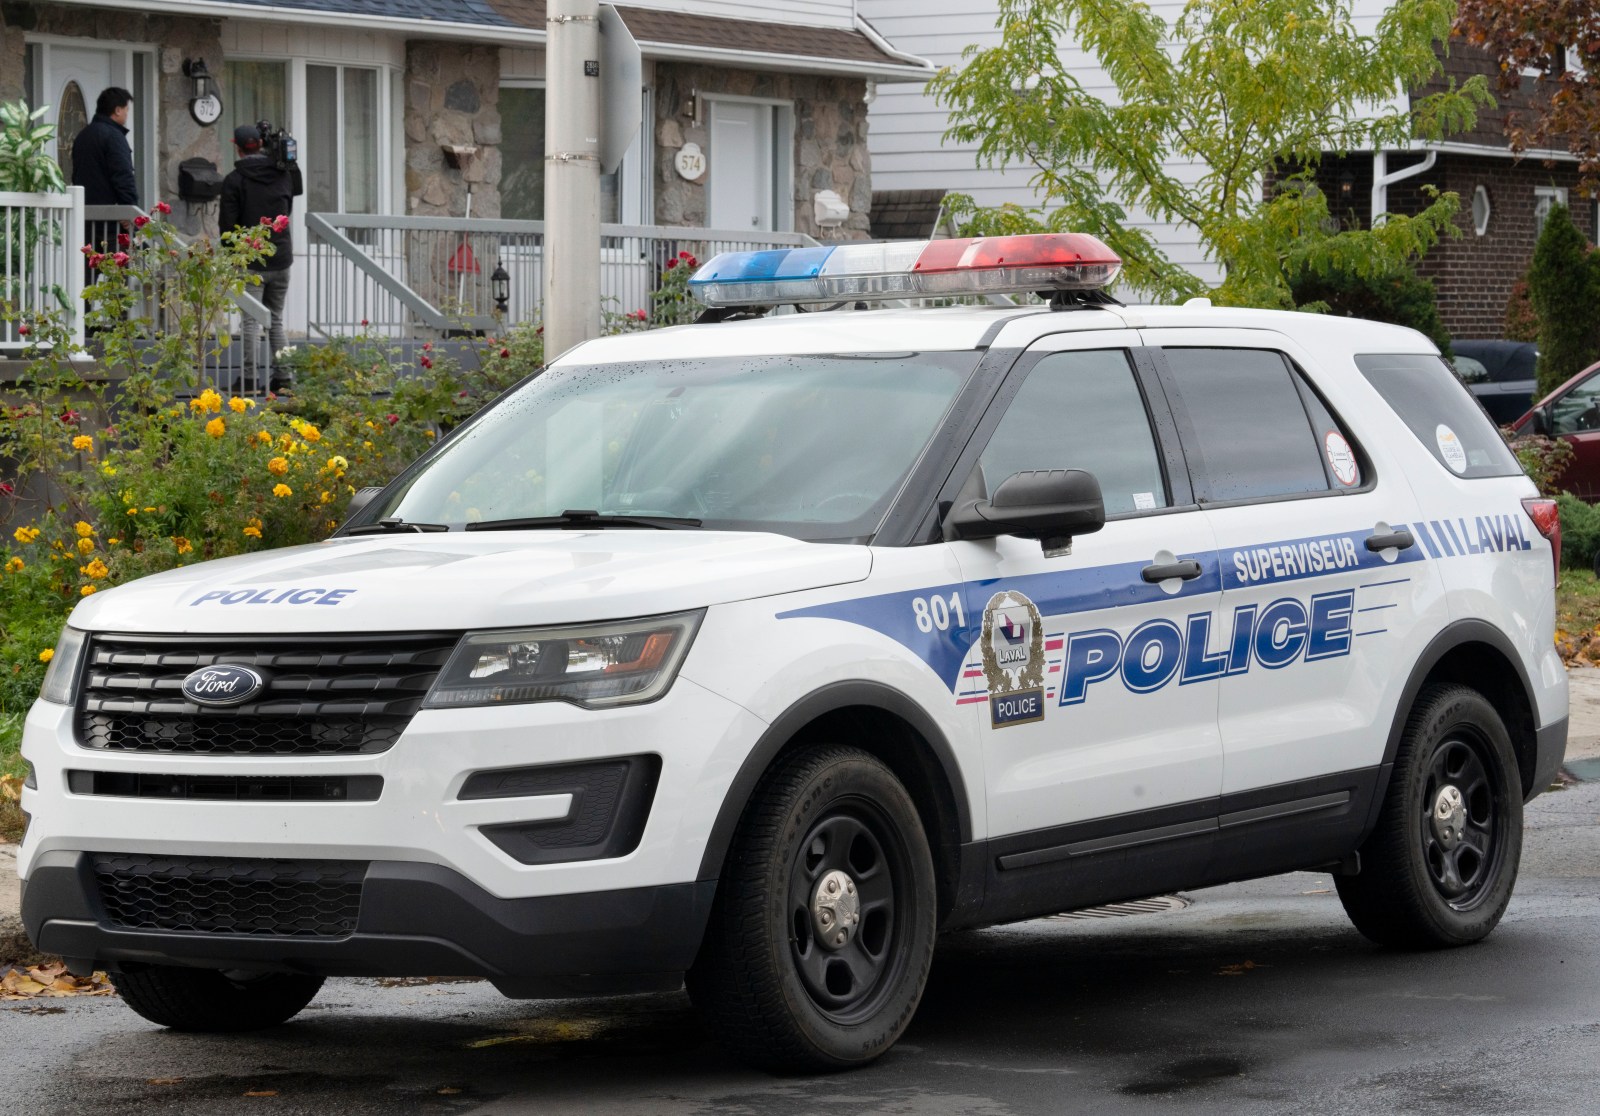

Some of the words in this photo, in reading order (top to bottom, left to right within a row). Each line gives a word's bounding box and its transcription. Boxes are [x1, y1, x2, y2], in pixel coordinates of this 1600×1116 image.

[200, 101, 214, 116] 572
[682, 155, 700, 171] 574
[1458, 514, 1532, 555] LAVAL
[1233, 537, 1359, 583] SUPERVISEUR
[189, 588, 358, 607] POLICE
[912, 591, 966, 633] 801
[1000, 647, 1027, 664] LAVAL
[1058, 588, 1355, 707] POLICE
[194, 670, 240, 693] Ford
[998, 698, 1037, 718] POLICE
